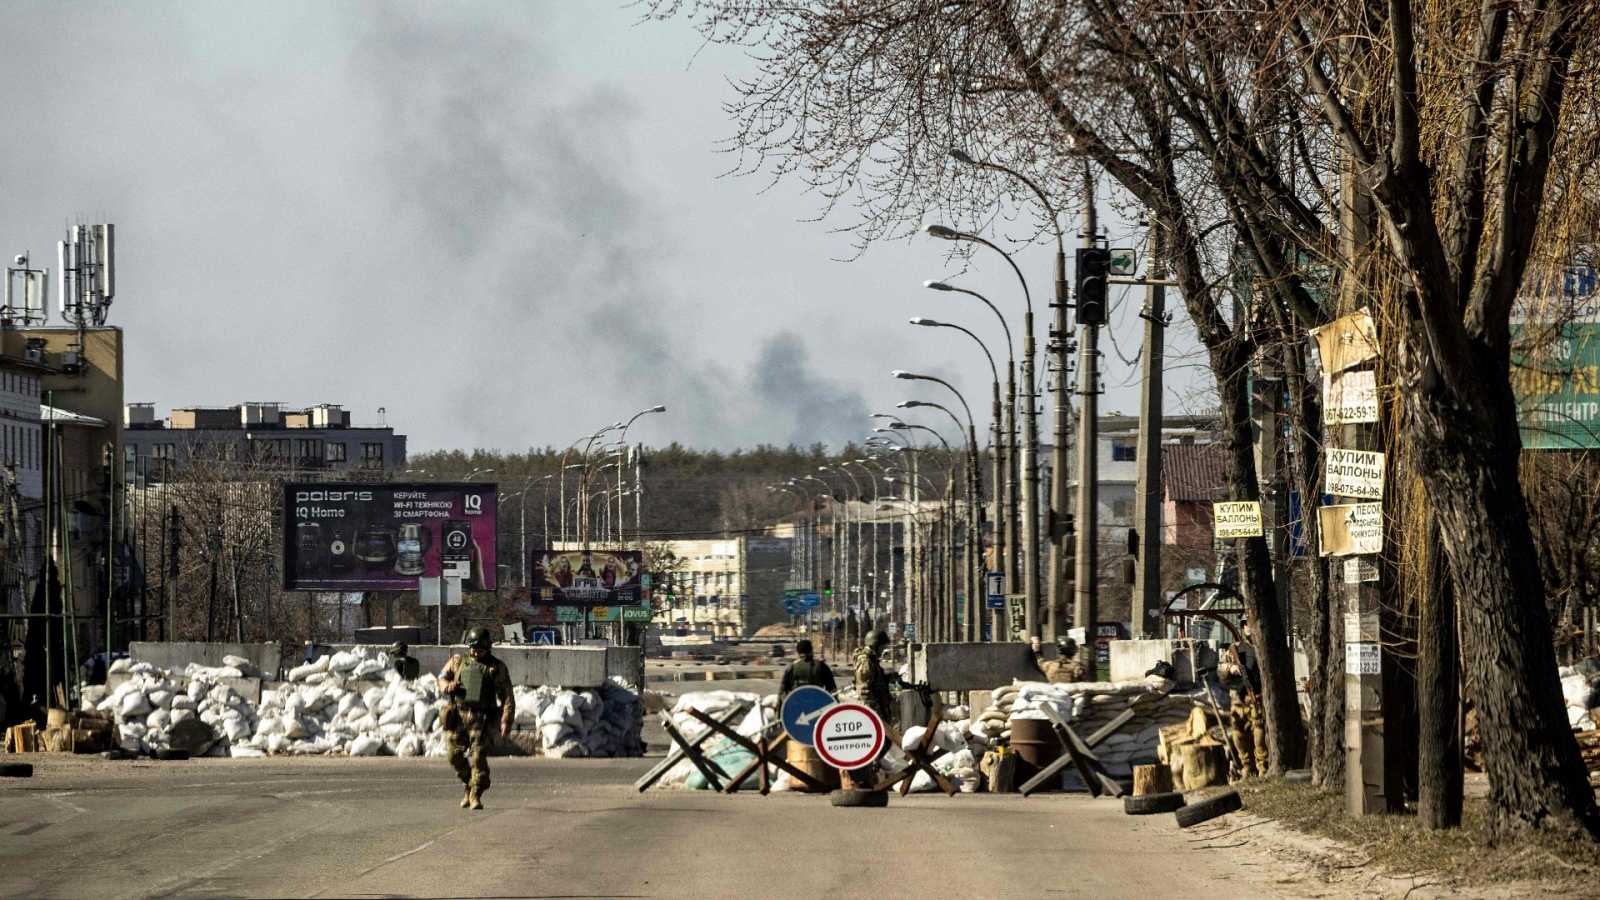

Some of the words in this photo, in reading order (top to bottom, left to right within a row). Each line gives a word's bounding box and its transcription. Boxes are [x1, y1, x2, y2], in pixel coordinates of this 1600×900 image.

[1332, 451, 1376, 465] КУПИМ
[1327, 464, 1382, 480] БАЛЛОНЫ
[296, 490, 373, 503] polaris
[465, 494, 482, 510] IQ
[296, 507, 308, 519] IQ
[311, 507, 345, 517] Home
[1220, 504, 1254, 513] КУПИМ
[1216, 514, 1260, 523] БАЛЛОНЫ
[835, 721, 863, 733] STOP
[828, 742, 871, 751] КОНТРОЛЬ
